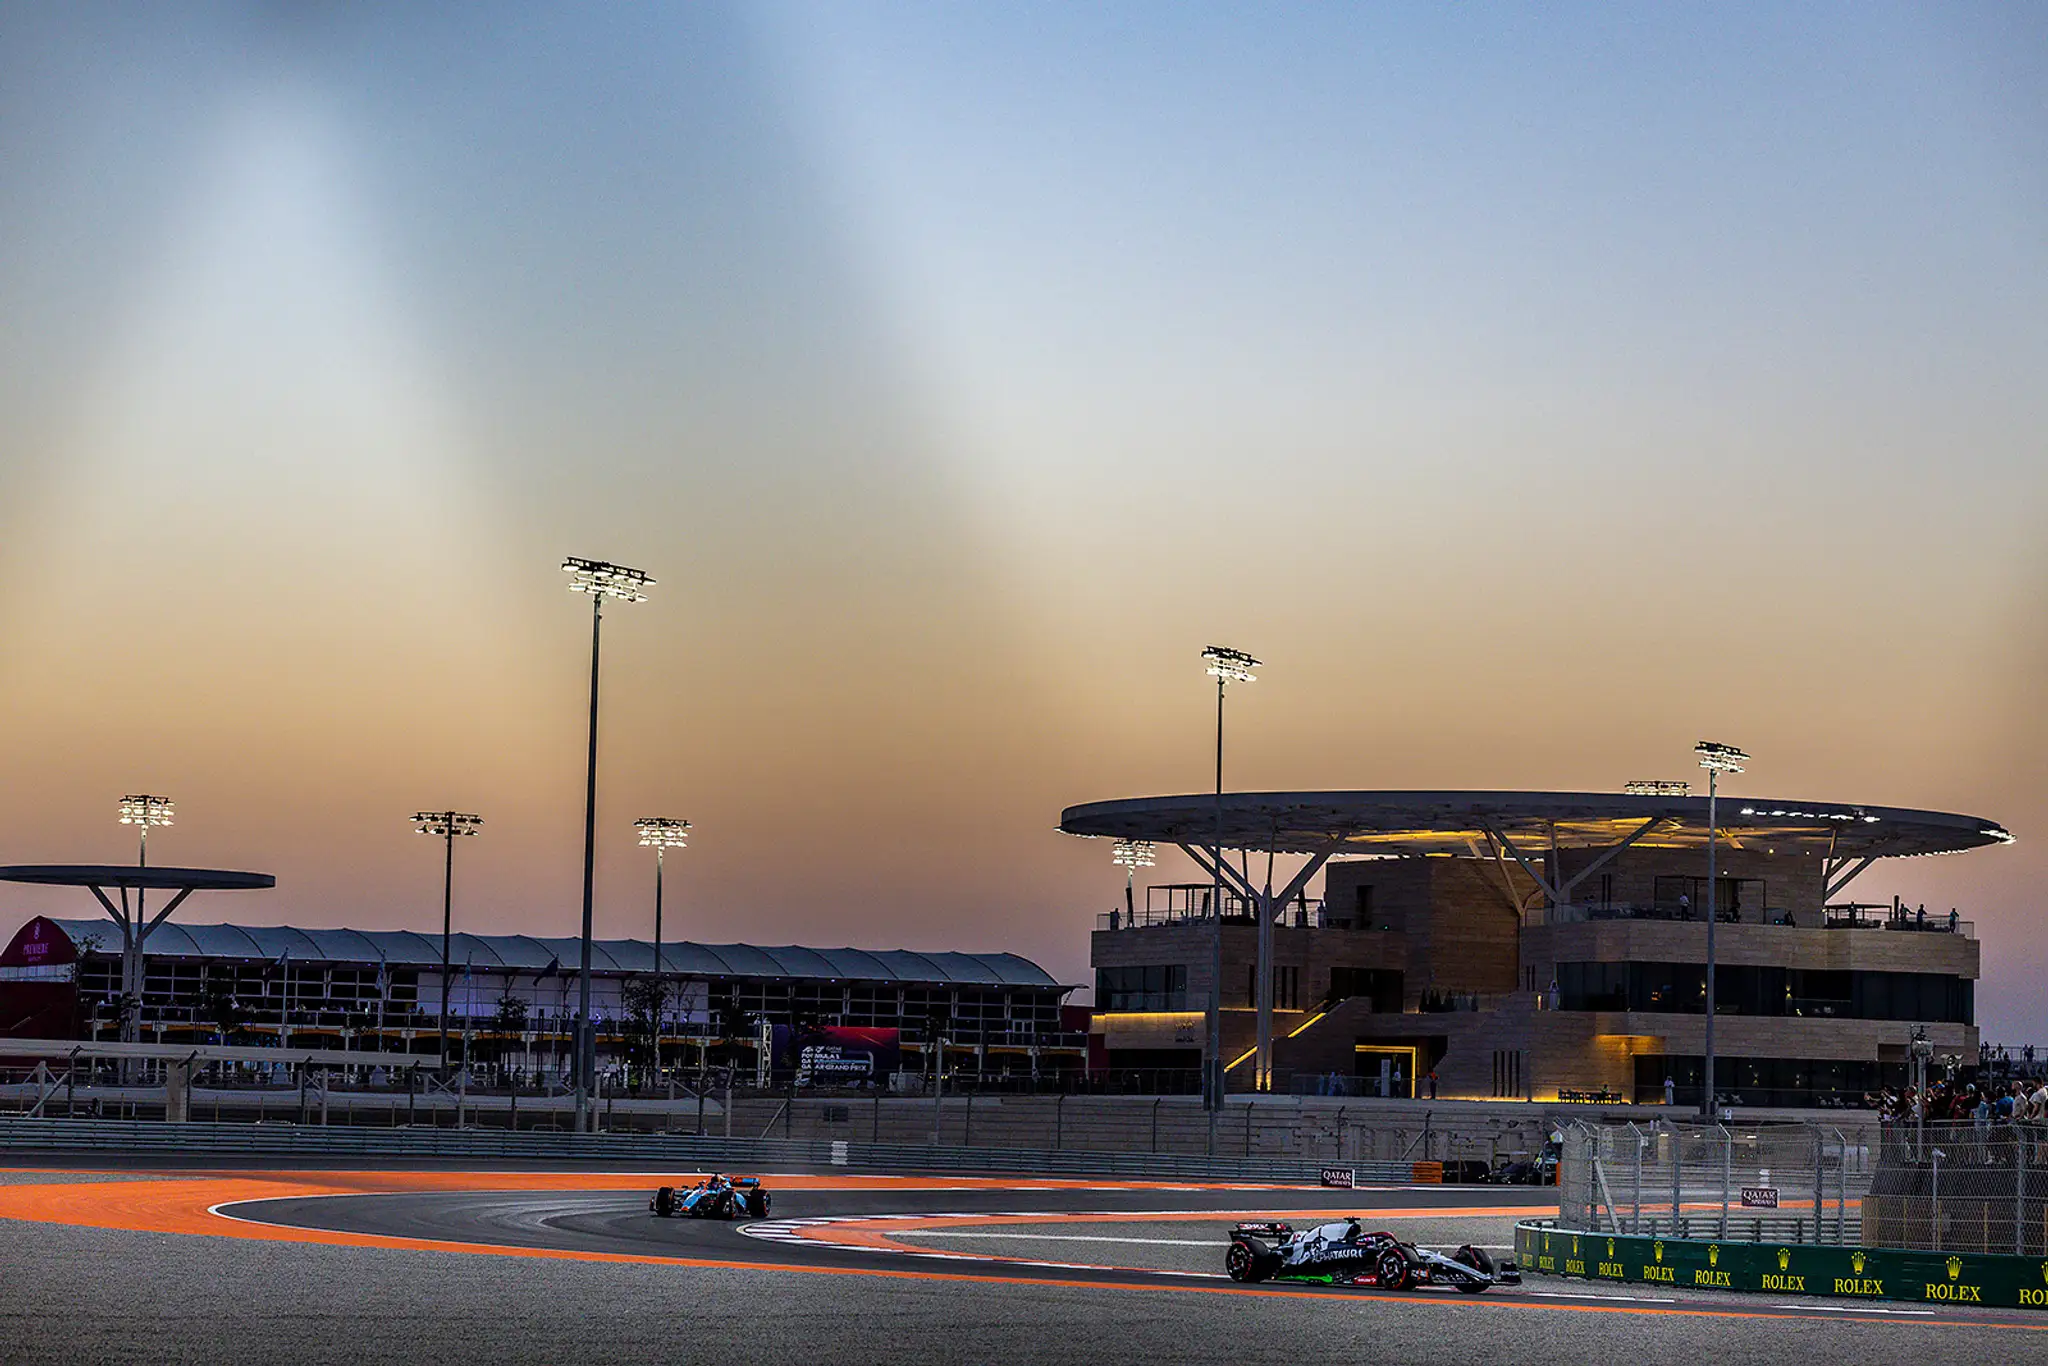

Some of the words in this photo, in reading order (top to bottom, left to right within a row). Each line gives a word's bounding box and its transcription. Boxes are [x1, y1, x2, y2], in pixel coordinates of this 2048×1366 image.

[1323, 1170, 1352, 1180] QATAR
[1743, 1190, 1776, 1200] QATAR
[1565, 1259, 1586, 1274] ROLEX
[1598, 1262, 1624, 1277] ROLEX
[1643, 1265, 1675, 1281] ROLEX
[1694, 1269, 1731, 1286] ROLEX
[1762, 1274, 1805, 1291] ROLEX
[1834, 1278, 1884, 1295] ROLEX
[1925, 1283, 1982, 1302] ROLEX
